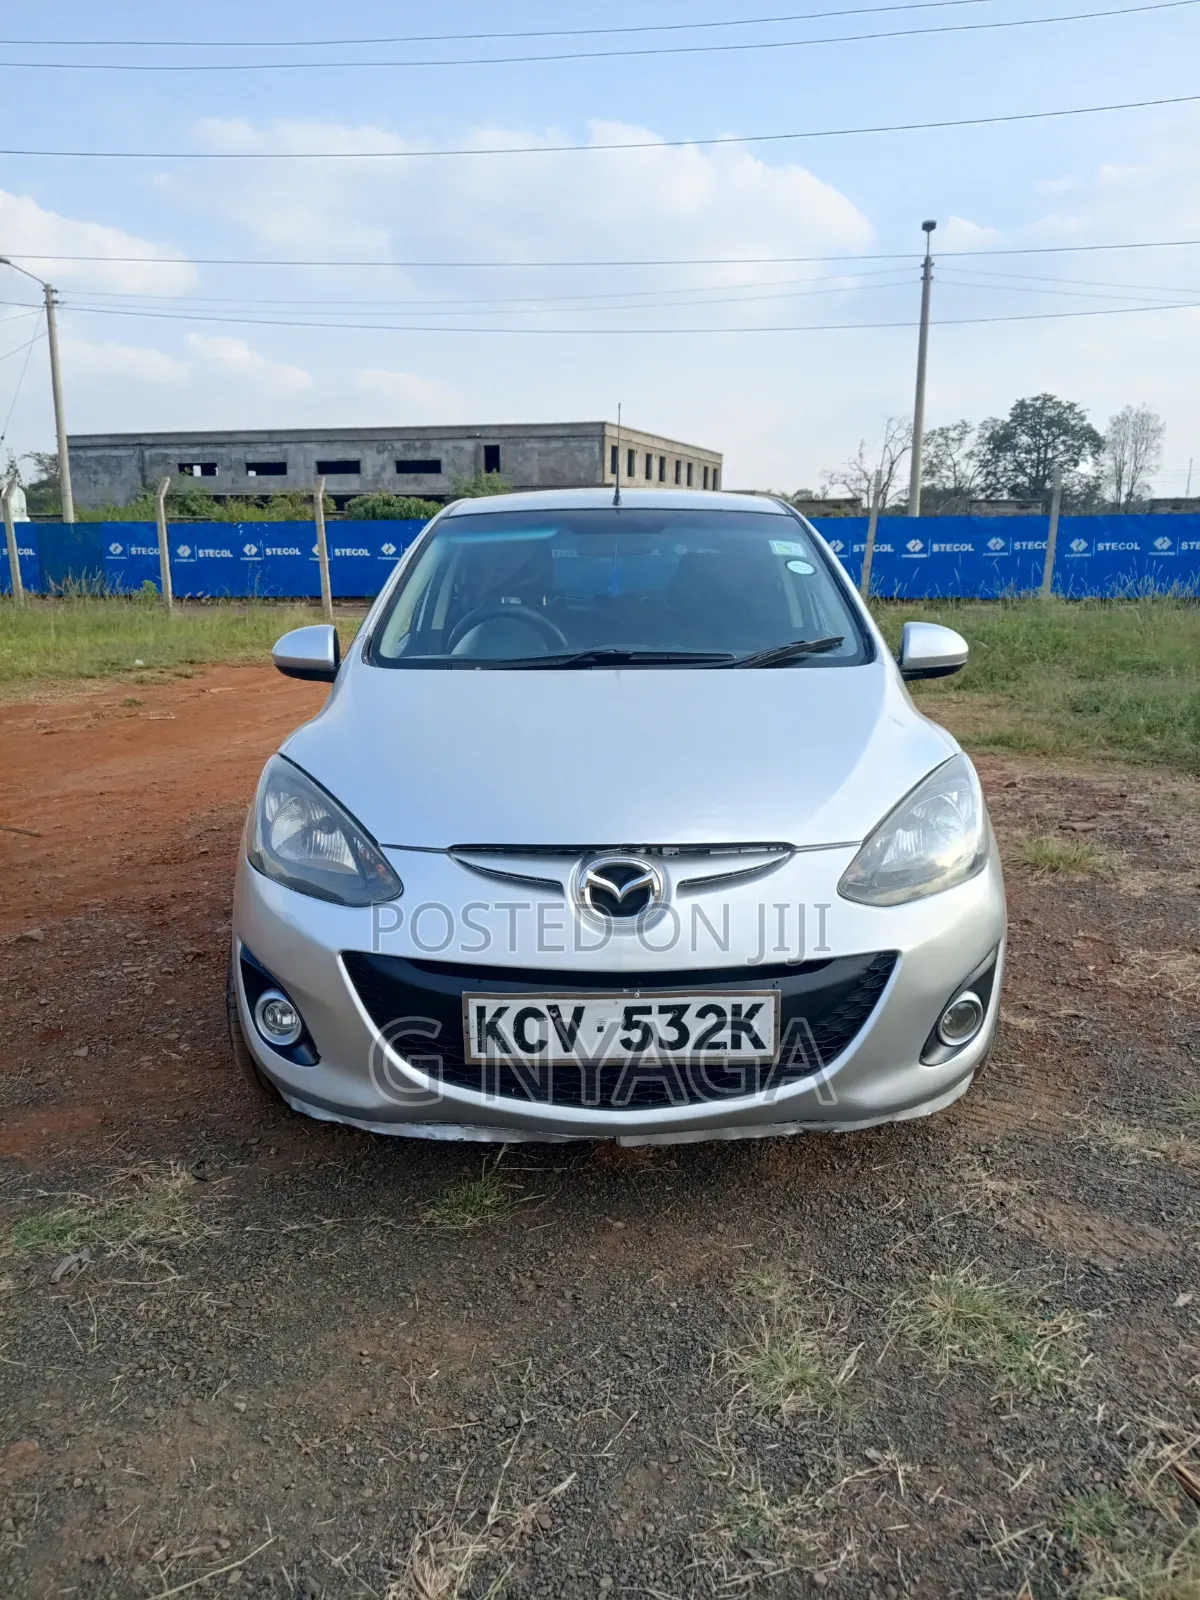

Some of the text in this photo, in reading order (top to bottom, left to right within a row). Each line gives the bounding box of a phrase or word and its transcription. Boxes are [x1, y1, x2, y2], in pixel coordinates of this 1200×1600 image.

[852, 544, 894, 553] STCOL
[932, 543, 975, 552] STECOL
[1013, 541, 1049, 550] STECO
[1097, 542, 1141, 551] STECOL
[2, 547, 36, 556] SCOL
[130, 547, 159, 556] STECO
[198, 549, 233, 558] STECOL
[265, 547, 301, 557] STECOL
[334, 548, 371, 557] STECOL
[476, 1003, 767, 1054] KCV 532K
